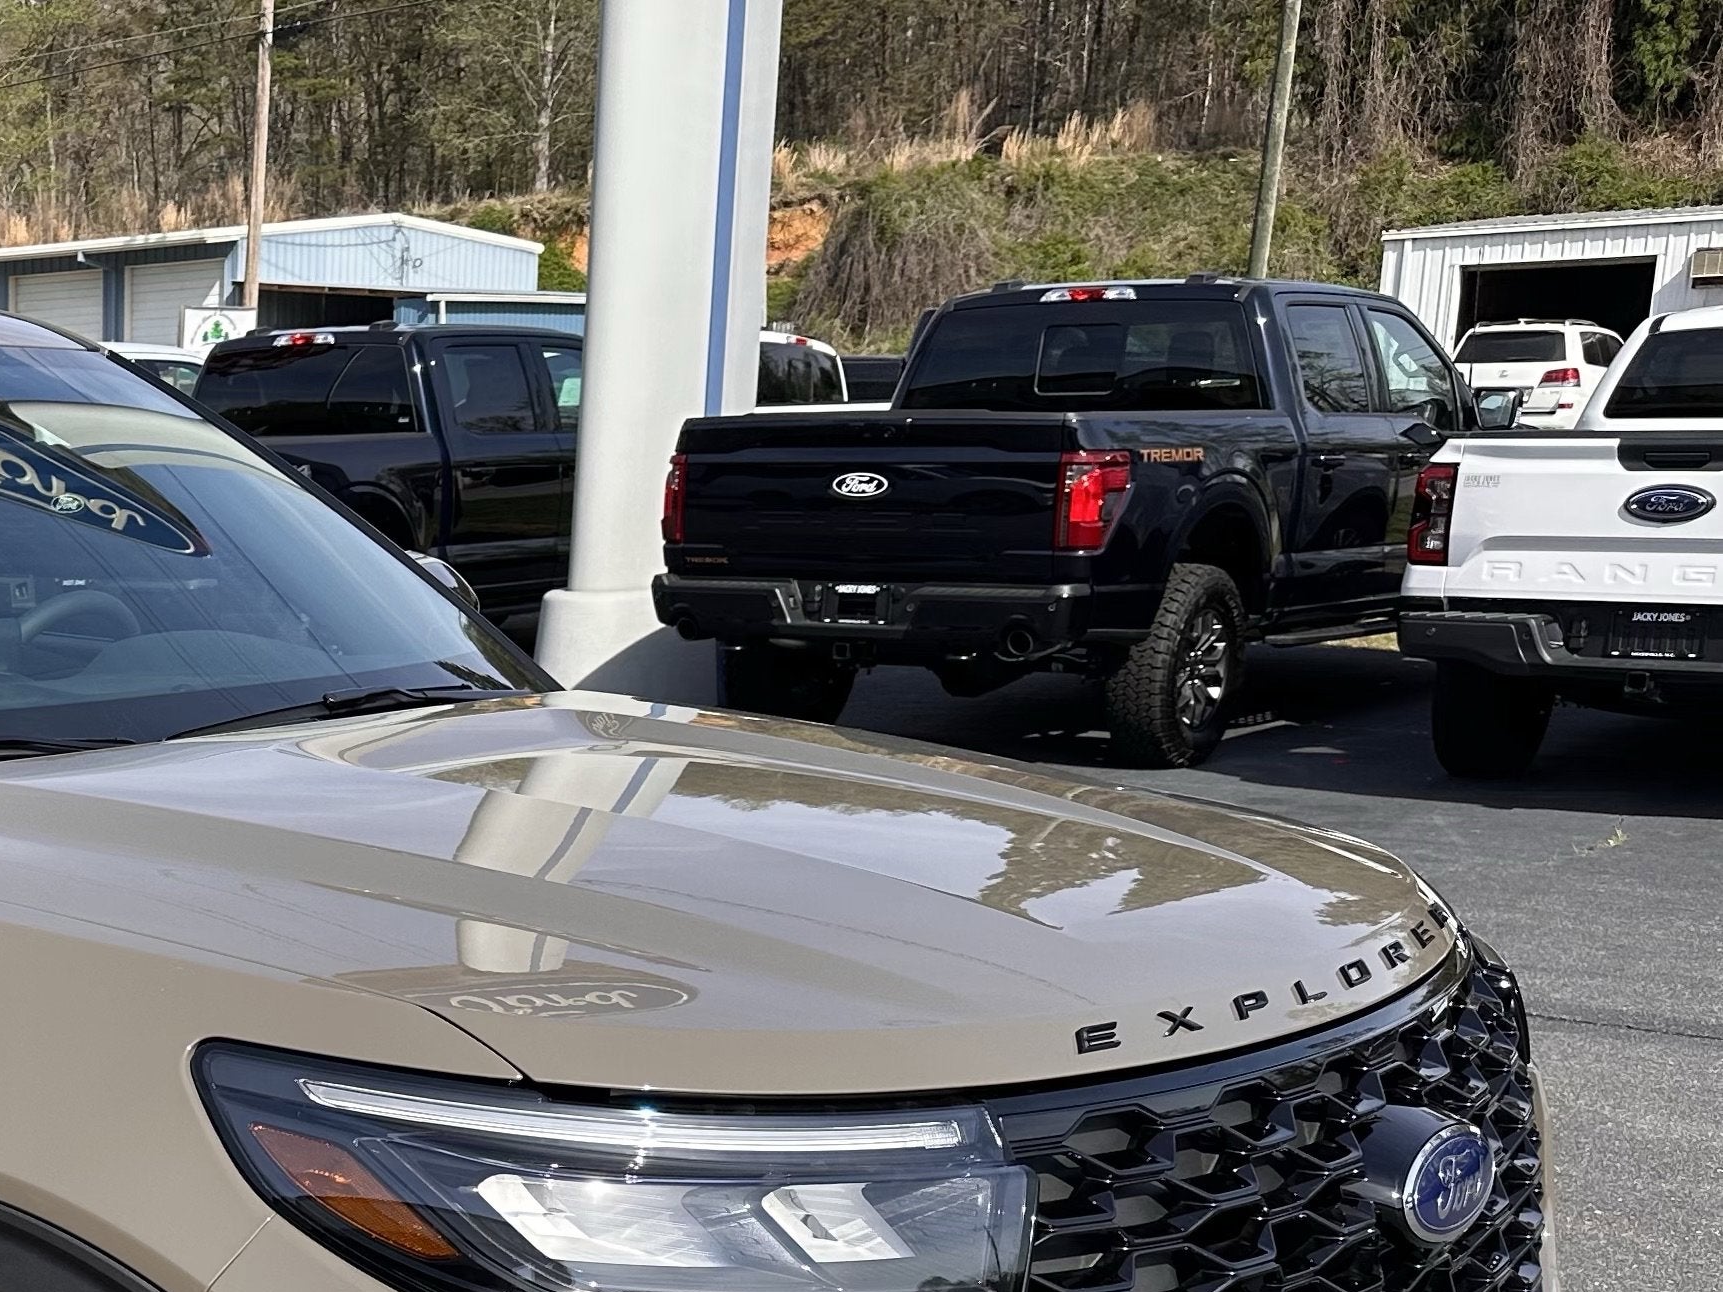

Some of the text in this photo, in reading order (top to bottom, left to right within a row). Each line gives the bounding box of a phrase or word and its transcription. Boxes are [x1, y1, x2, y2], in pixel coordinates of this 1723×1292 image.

[1139, 447, 1205, 463] TREMOR
[1631, 611, 1686, 623] JACKY JONES
[1436, 1148, 1482, 1220] Ford
